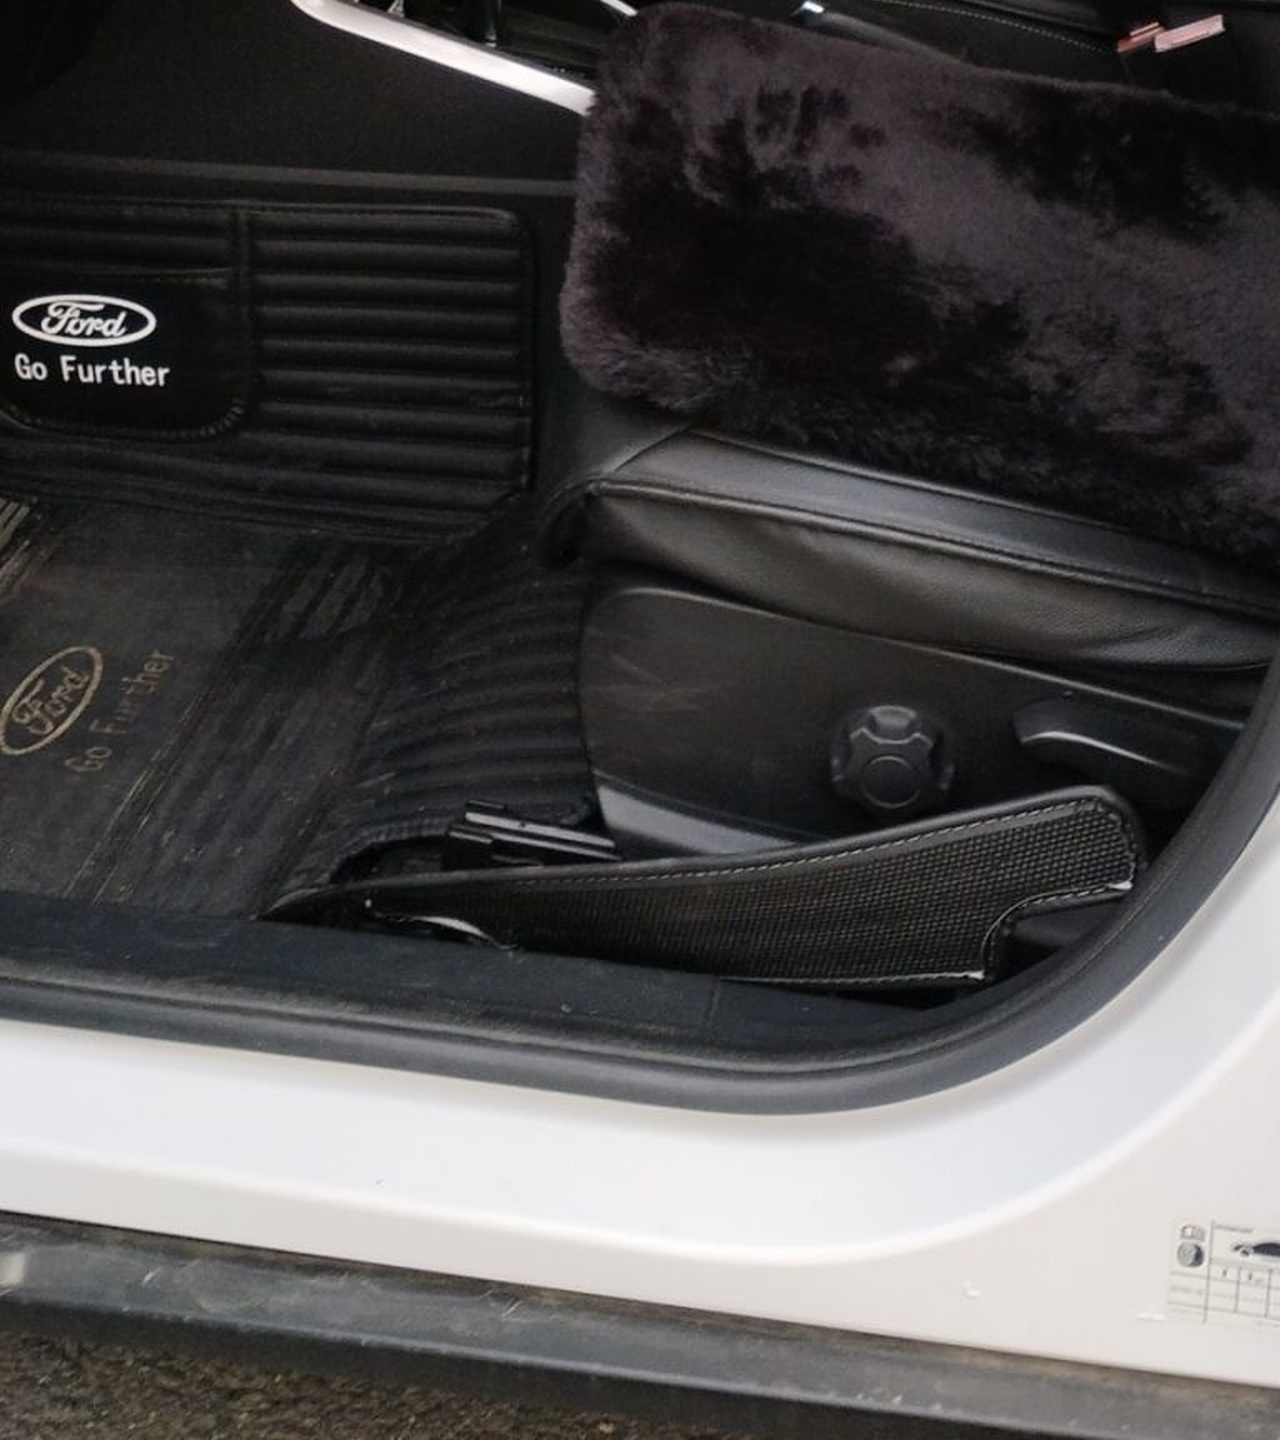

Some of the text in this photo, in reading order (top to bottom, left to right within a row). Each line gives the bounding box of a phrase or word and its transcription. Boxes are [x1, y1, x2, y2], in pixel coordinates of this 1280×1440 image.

[40, 301, 128, 338] Ford
[14, 353, 171, 386] Go Further
[11, 665, 91, 735] Ford
[63, 745, 114, 773] Go
